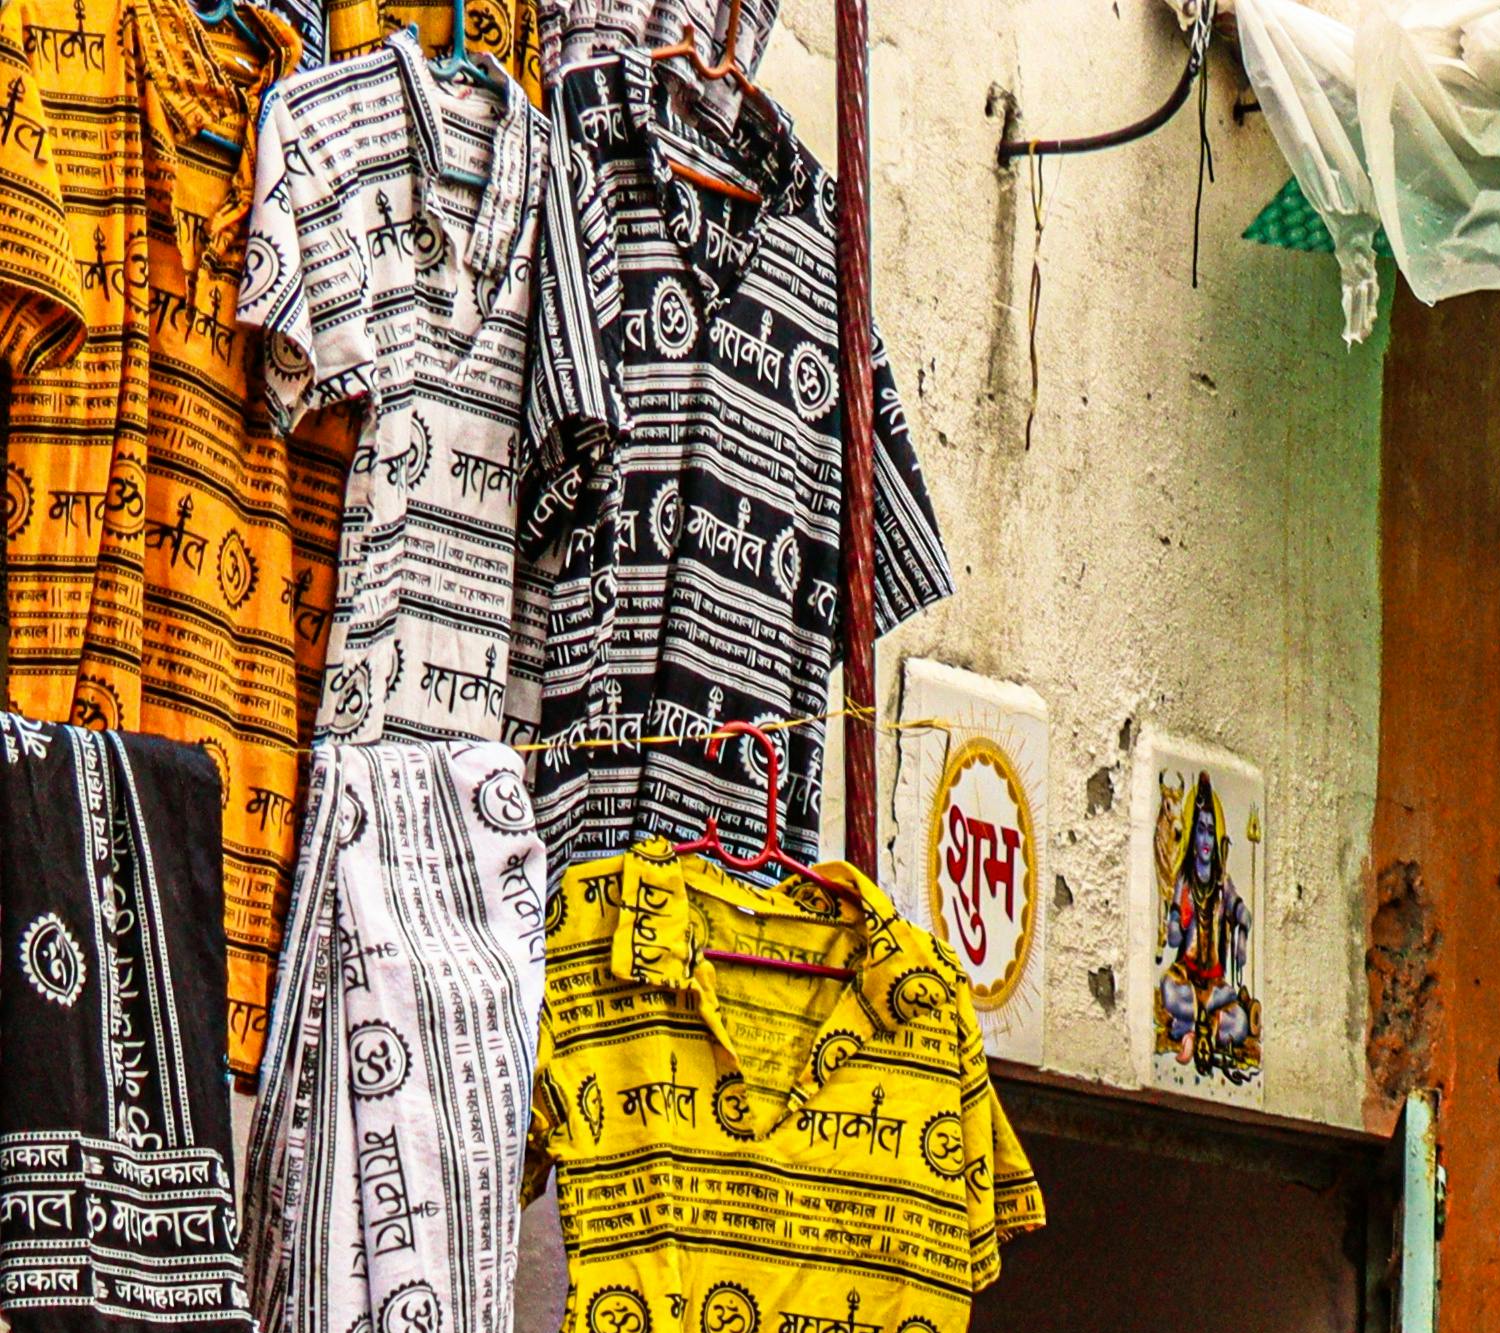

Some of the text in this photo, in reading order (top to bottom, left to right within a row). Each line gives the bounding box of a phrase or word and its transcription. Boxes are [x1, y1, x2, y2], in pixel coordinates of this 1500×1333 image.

[25, 0, 106, 73] महाकाल
[709, 309, 784, 389] महाकाल
[688, 497, 765, 577] महाकाल
[422, 643, 507, 721] महाकाल
[946, 804, 1021, 966] शुभ
[797, 1082, 907, 1159] महाकाल
[111, 1200, 216, 1246] महाकाल
[360, 1125, 439, 1257] महाकाल
[726, 1183, 779, 1203] महाकाल
[801, 1193, 821, 1208] जय
[824, 1196, 877, 1219] महाकाल
[903, 1209, 924, 1225] जय
[723, 1211, 777, 1235] महाकाल
[799, 1225, 820, 1240] जय
[898, 1240, 919, 1255] जय
